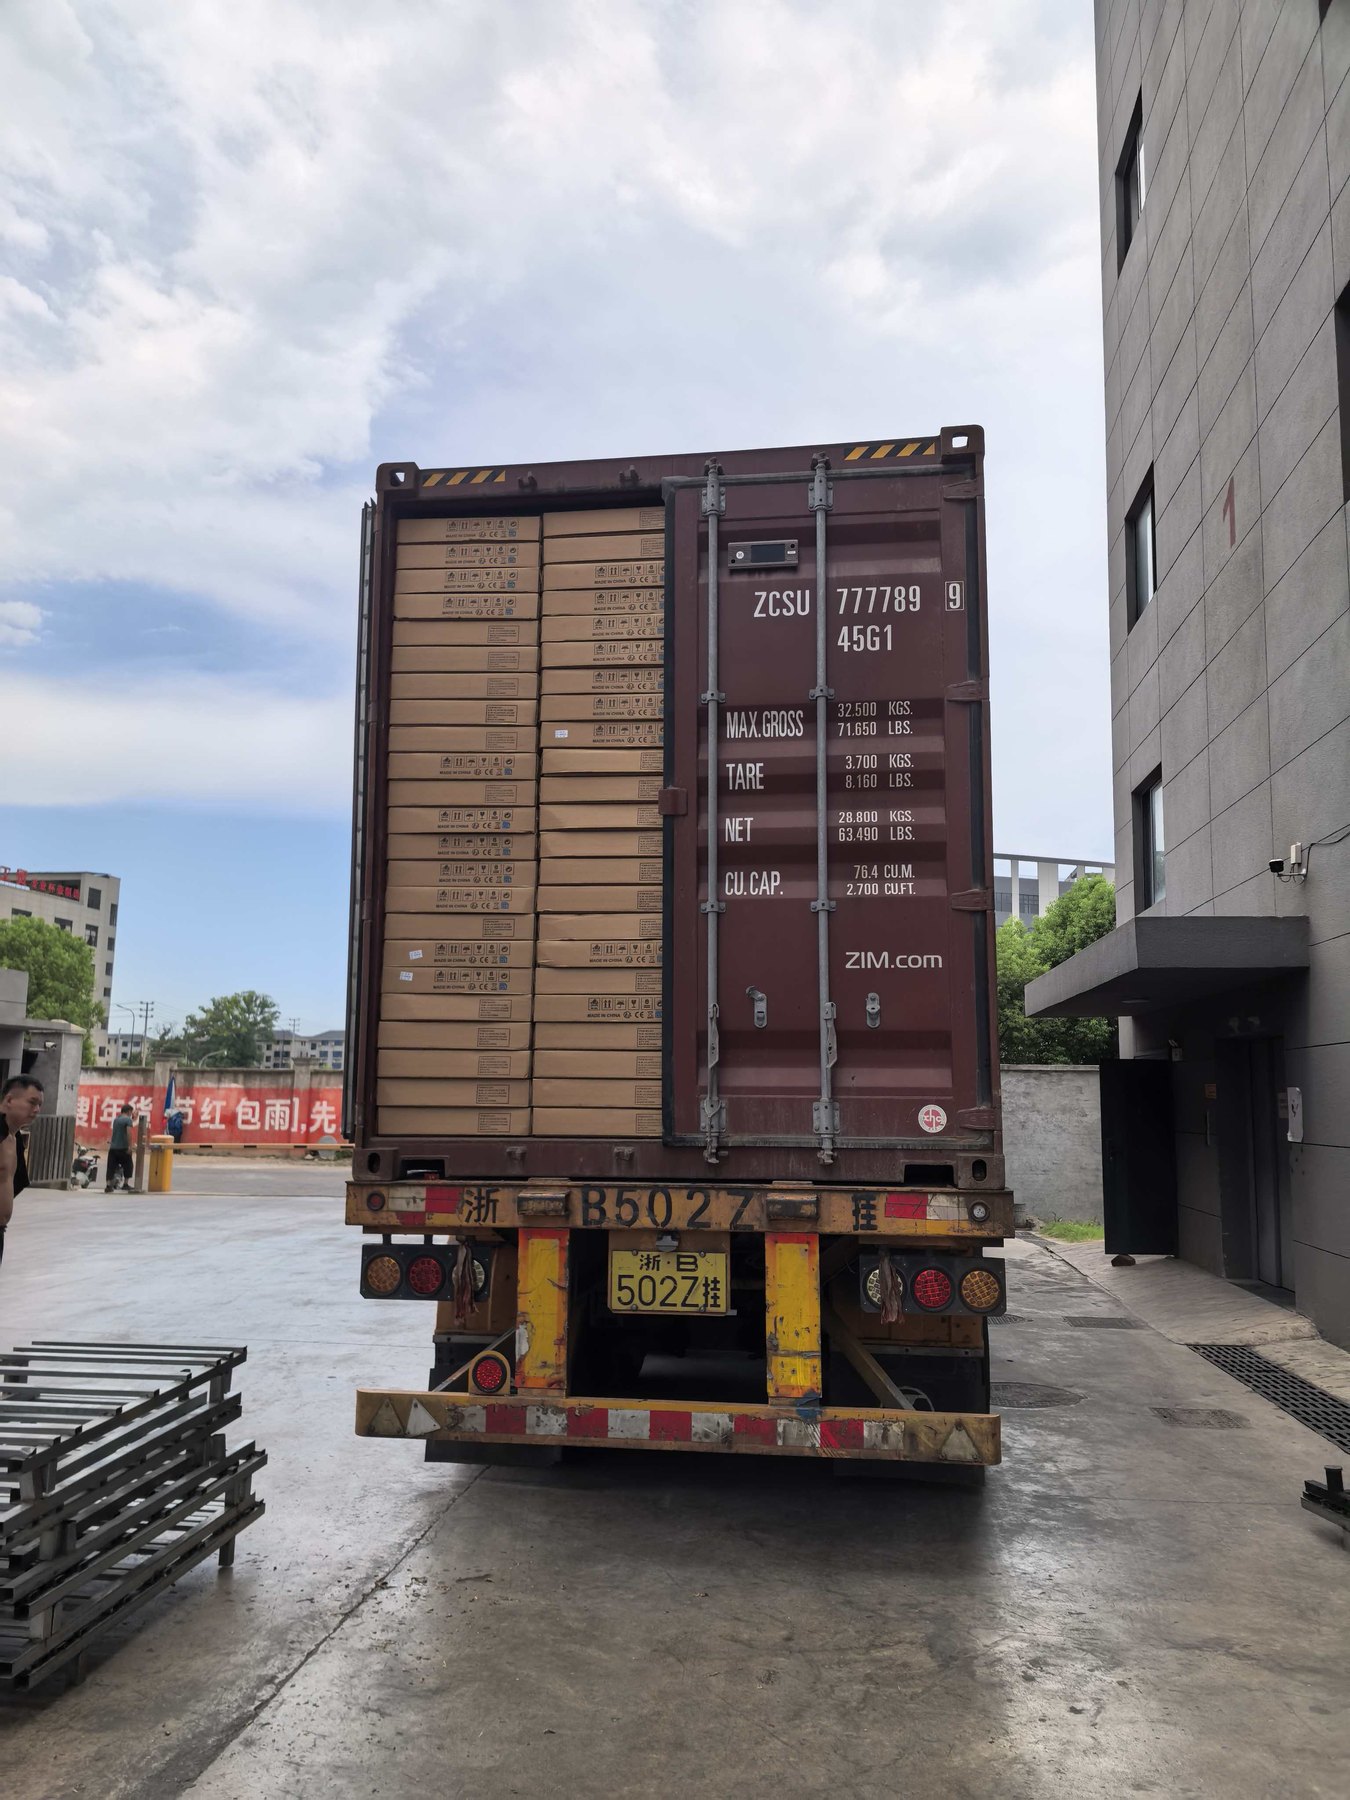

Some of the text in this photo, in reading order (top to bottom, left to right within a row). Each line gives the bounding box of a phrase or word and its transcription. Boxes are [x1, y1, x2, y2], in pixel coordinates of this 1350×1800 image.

[754, 583, 961, 617] ZCSU 777789 9
[837, 624, 892, 652] 45G1
[889, 701, 912, 715] KGS.
[726, 710, 803, 738] MAX.GROSS
[889, 721, 912, 734] LBS.
[889, 754, 914, 767] KGS.
[726, 763, 764, 790] TARE
[889, 773, 914, 787] LBS.
[890, 811, 915, 822] KGS.
[725, 818, 753, 841] NET
[891, 827, 915, 840] LBS.
[854, 864, 915, 879] 76.4 CU.M.
[845, 952, 942, 968] ZIM.com
[464, 1187, 500, 1223] 浙
[852, 1192, 878, 1231] 挂
